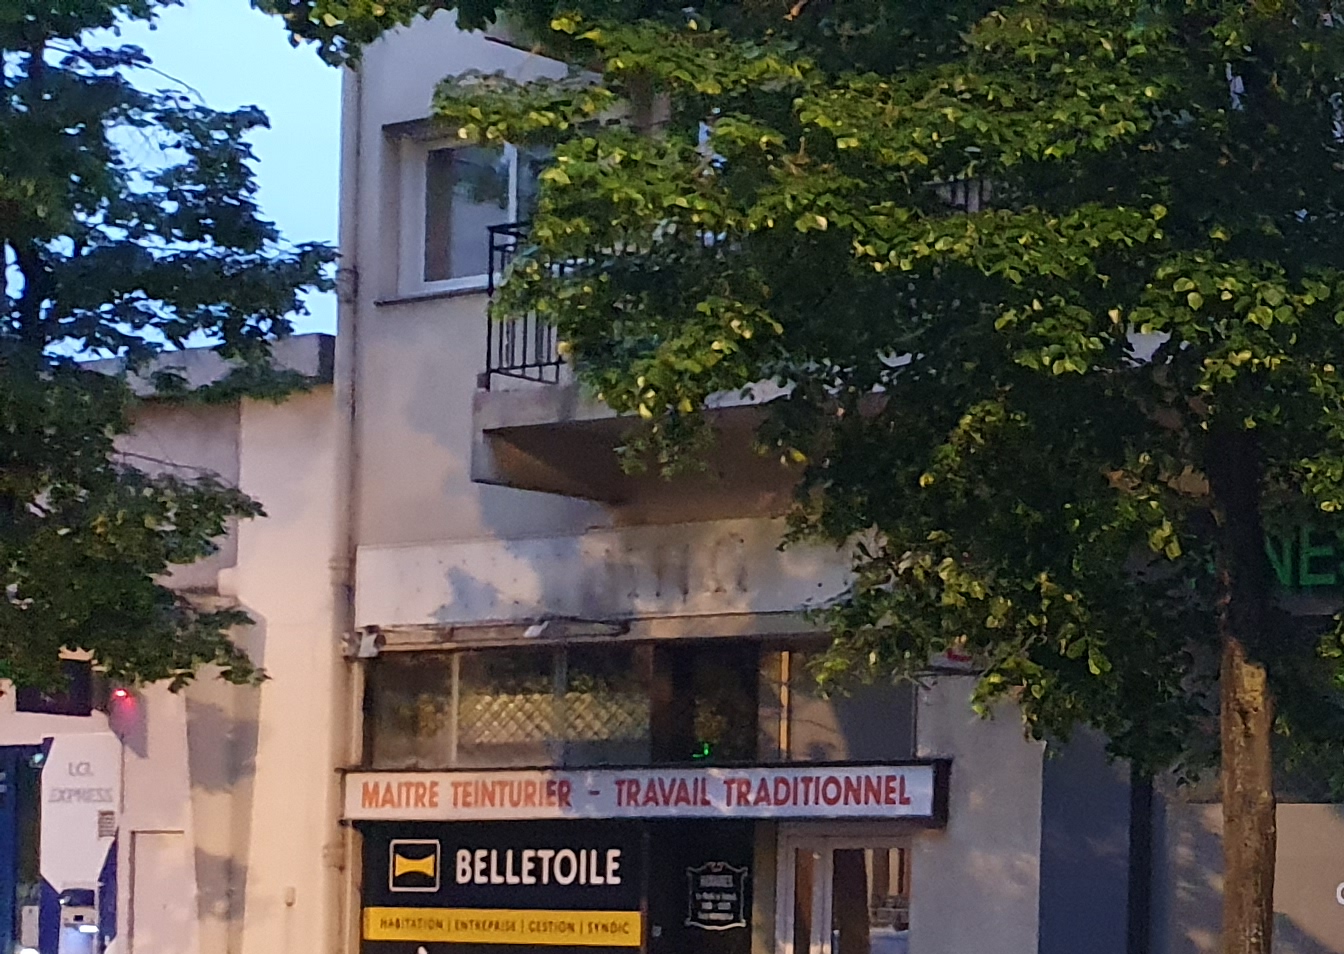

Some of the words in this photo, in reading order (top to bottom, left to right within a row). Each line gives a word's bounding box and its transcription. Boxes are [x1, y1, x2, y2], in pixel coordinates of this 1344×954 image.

[361, 780, 439, 808] MAITRE
[450, 779, 573, 808] TEINTURIER
[614, 776, 711, 807] TRAVAIL
[724, 774, 911, 807] TRADITIONNEL
[456, 848, 622, 885] BELLETOILE
[380, 918, 444, 930] HABITATION
[454, 918, 517, 932] ENTREPRISE
[528, 920, 576, 933] GESTION
[588, 921, 630, 935] SYNDIC
